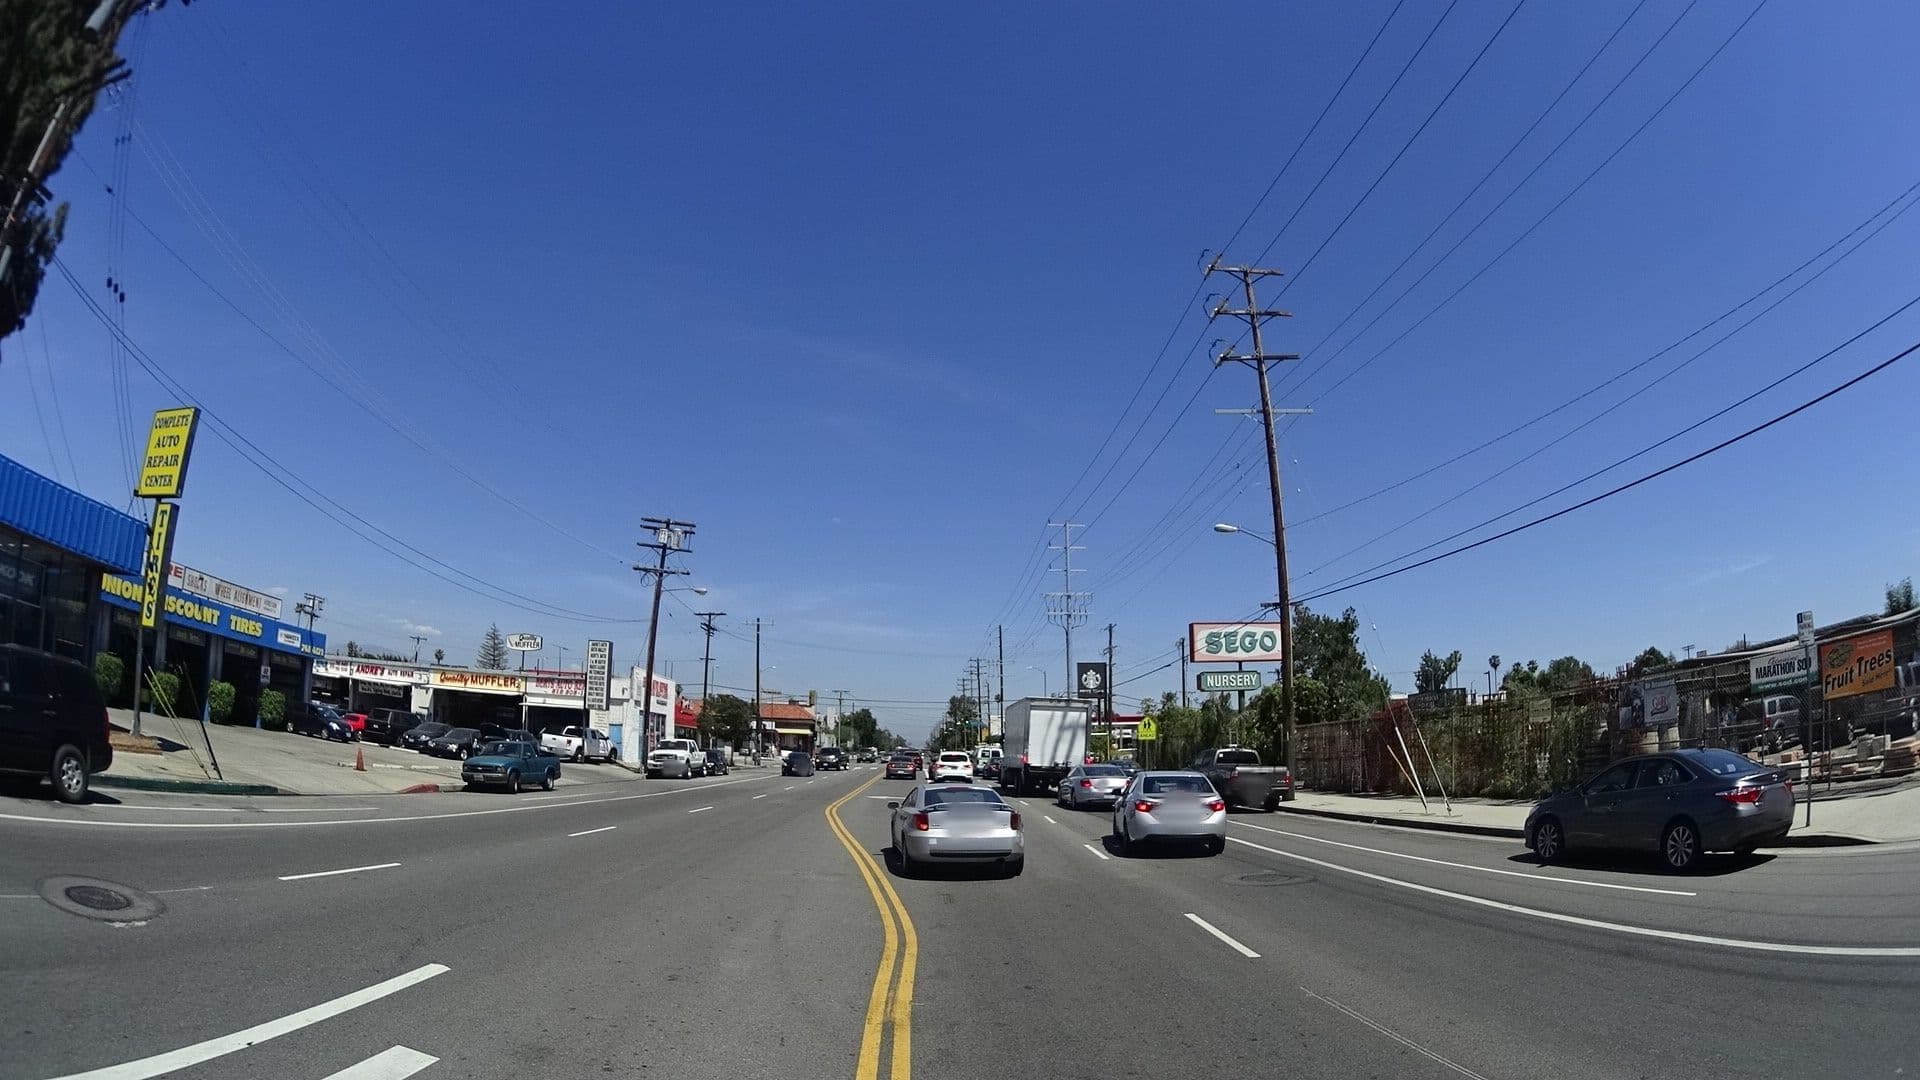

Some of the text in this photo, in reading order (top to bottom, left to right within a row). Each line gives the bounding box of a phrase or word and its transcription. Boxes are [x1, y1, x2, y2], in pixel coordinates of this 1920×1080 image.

[155, 415, 190, 429] COMPLETE
[155, 435, 180, 448] AUTO
[146, 455, 179, 468] REPAIR
[145, 475, 173, 487] CENTER
[230, 614, 263, 637] TIRES
[1205, 631, 1277, 654] SEGO
[356, 664, 386, 676] ANDRE'S
[1755, 660, 1795, 680] MARATHON
[1824, 649, 1892, 693] Fruit Trees
[471, 674, 516, 688] MUFFLER
[1207, 674, 1258, 687] NURSERY
